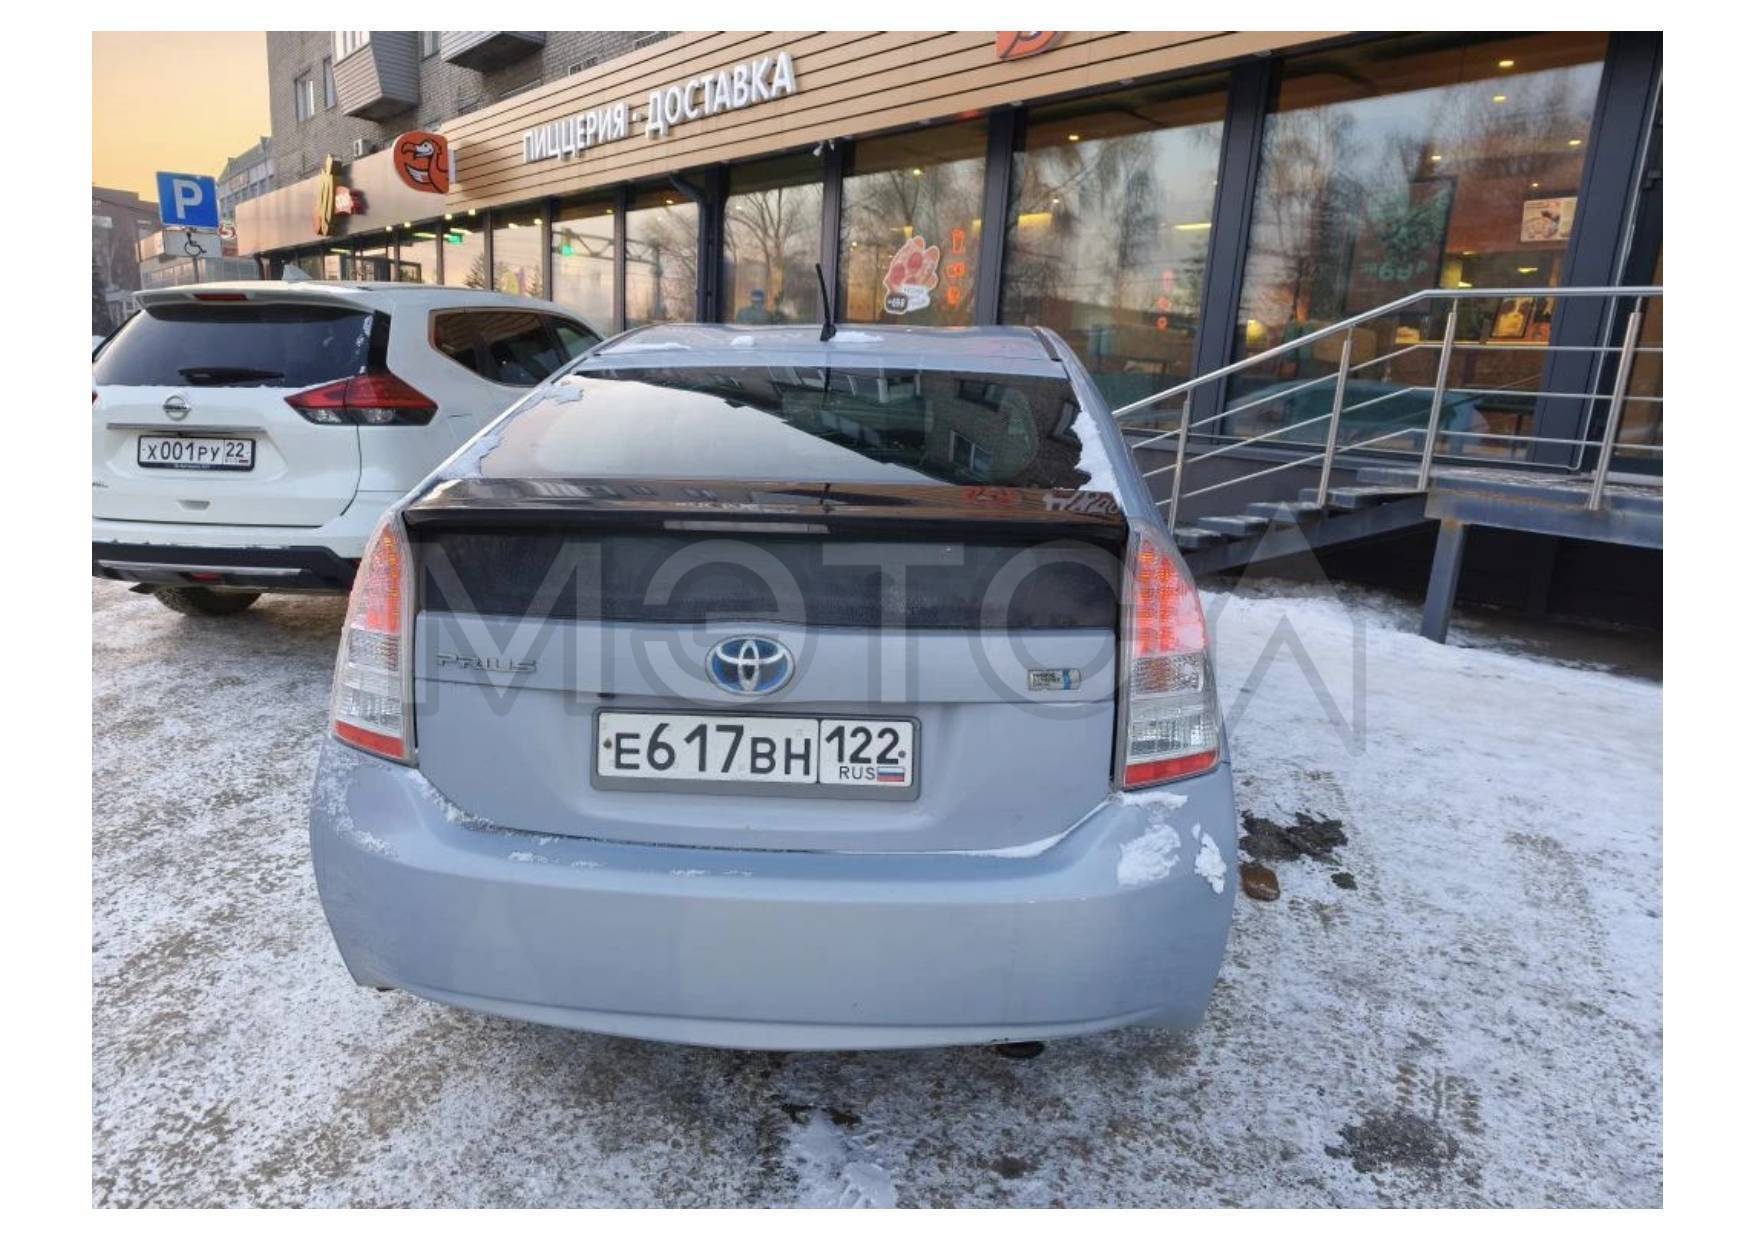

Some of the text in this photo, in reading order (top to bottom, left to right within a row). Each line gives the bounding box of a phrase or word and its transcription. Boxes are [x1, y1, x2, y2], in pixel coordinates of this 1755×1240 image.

[523, 52, 796, 161] ПИЦЦЕРИЯ ДОСТАВКА
[172, 178, 203, 220] P
[147, 441, 245, 461] Х001РУ 22
[436, 652, 537, 674] PRIUS
[614, 723, 900, 776] Е617ВН 122
[838, 765, 876, 780] RUS
